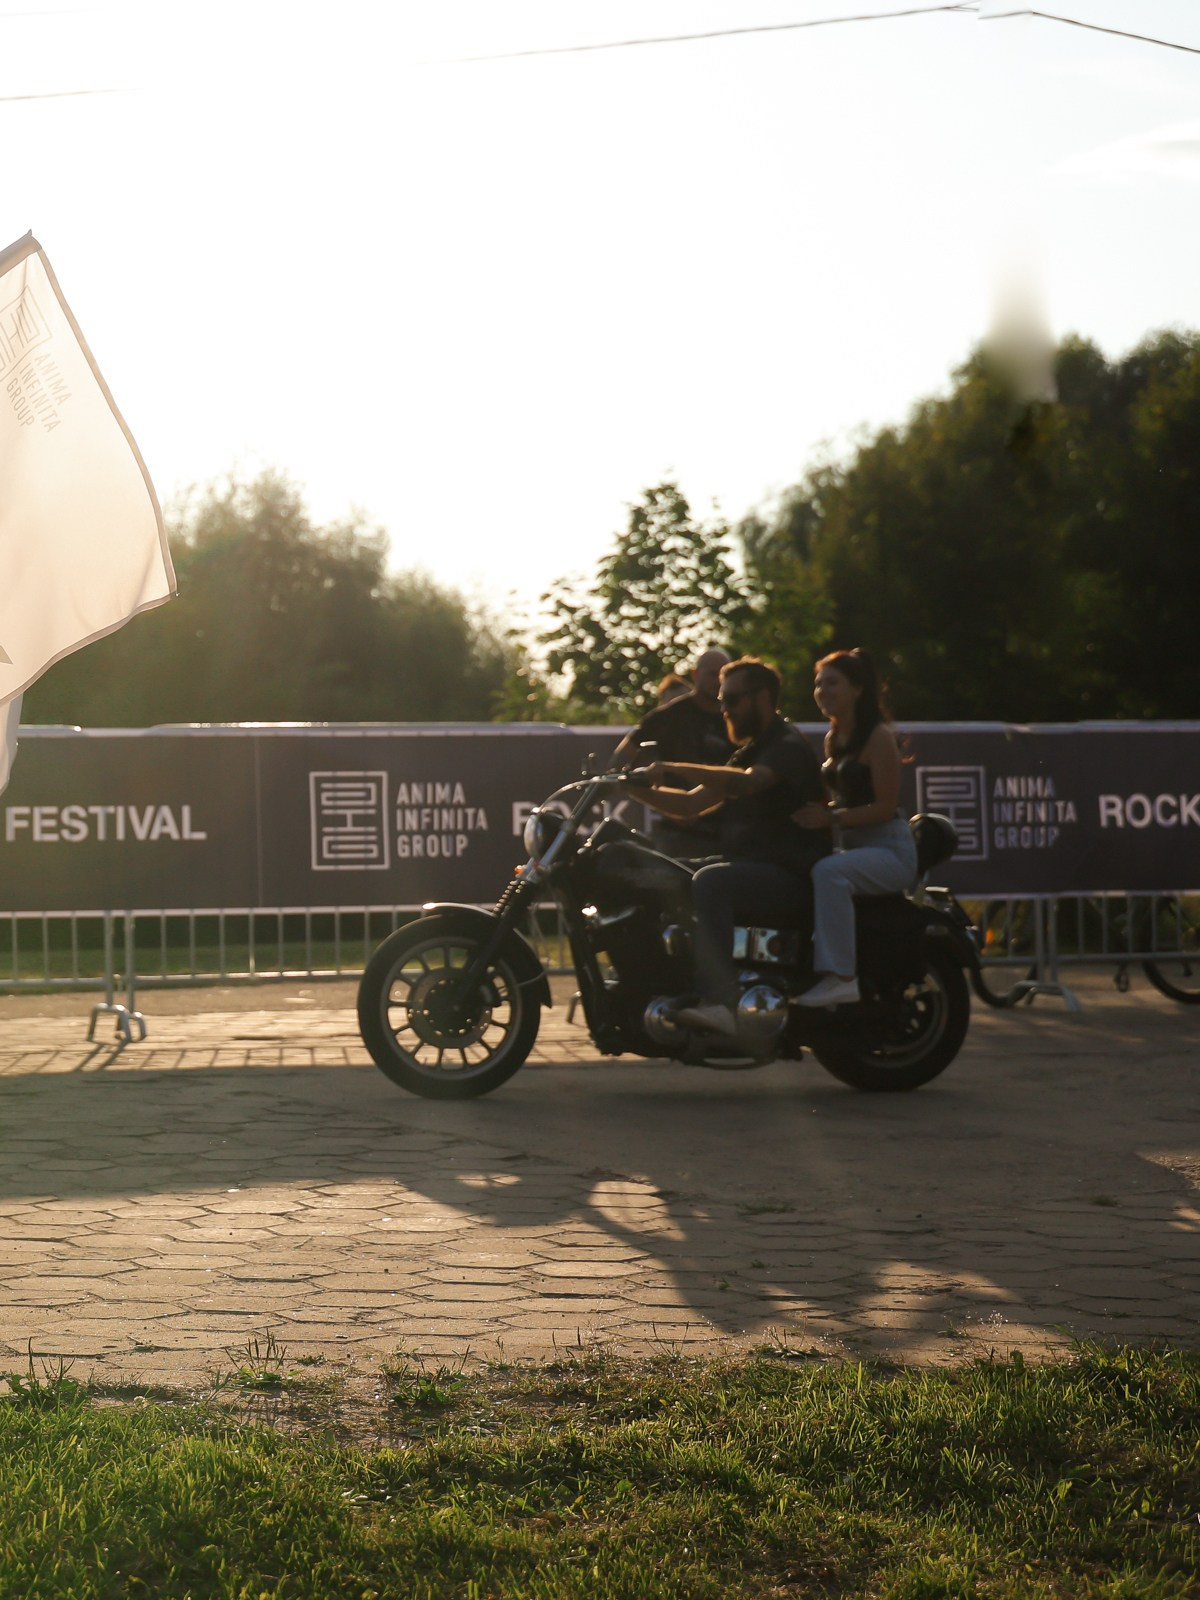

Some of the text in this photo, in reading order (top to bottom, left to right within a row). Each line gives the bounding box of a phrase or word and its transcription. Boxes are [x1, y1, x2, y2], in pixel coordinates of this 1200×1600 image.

[34, 352, 72, 406] ANIMA
[6, 377, 35, 427] GROUP
[19, 362, 62, 433] INFINITA
[396, 782, 467, 805] ANIMA
[993, 776, 1055, 799] ANIMA
[5, 804, 208, 842] FESTIVAL
[396, 807, 489, 831] INFINITA
[993, 800, 1077, 823] INFINITA
[1098, 793, 1200, 829] ROCK
[397, 834, 469, 858] GROUP
[994, 826, 1059, 849] GROUP
